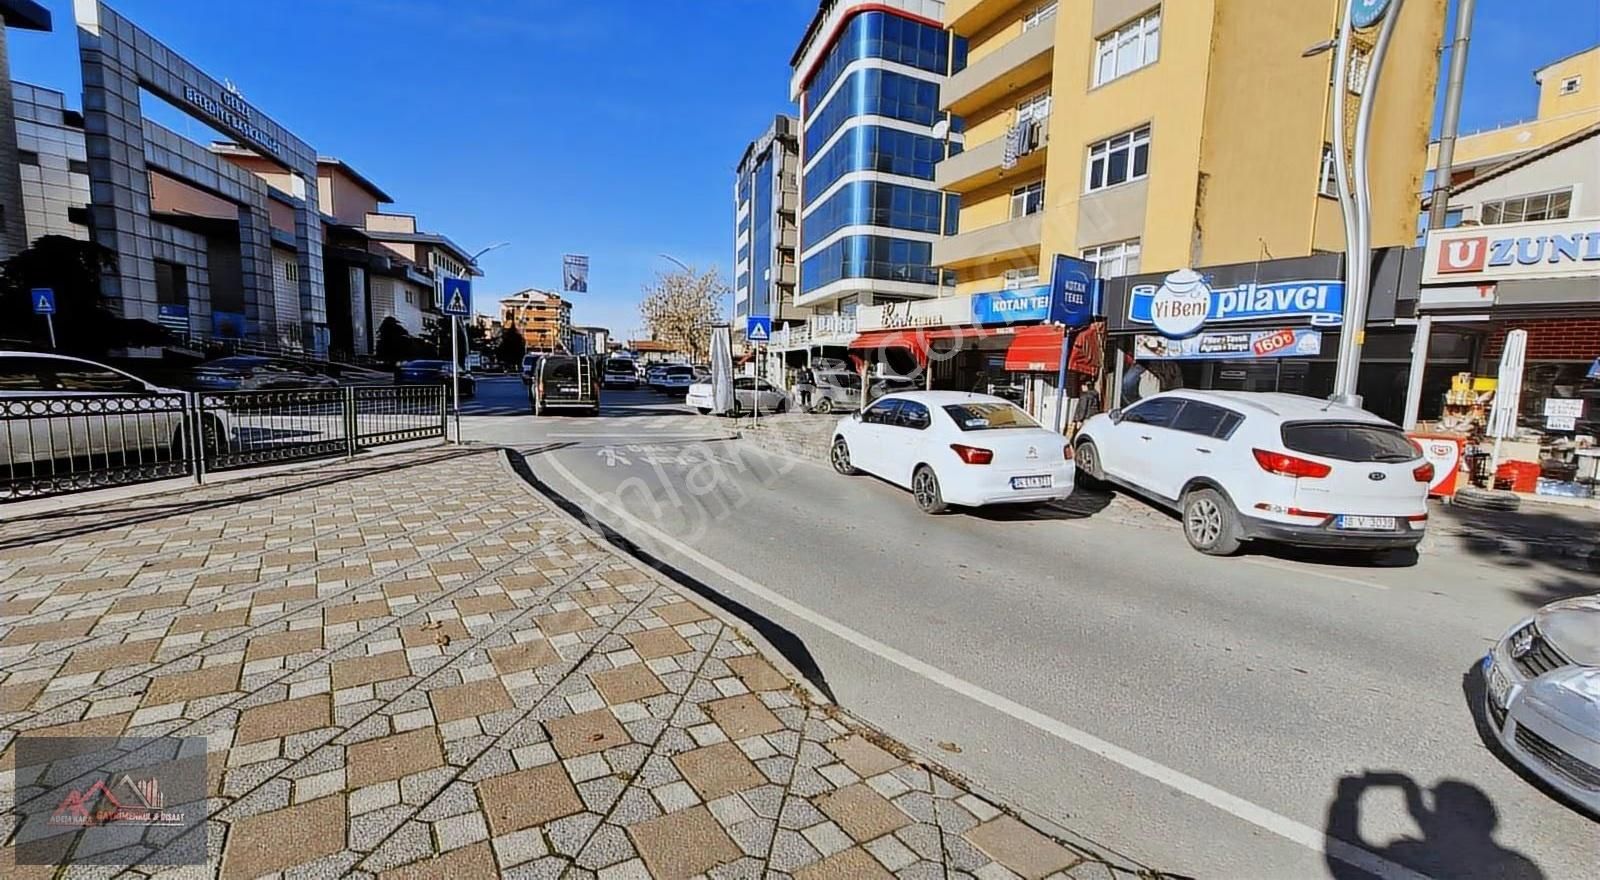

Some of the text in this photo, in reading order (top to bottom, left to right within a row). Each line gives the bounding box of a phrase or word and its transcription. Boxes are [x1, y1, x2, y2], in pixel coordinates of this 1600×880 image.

[1065, 280, 1086, 293] KOTAN
[992, 297, 1029, 312] KOTAN
[1065, 292, 1084, 304] TEKEL
[1155, 297, 1207, 318] Yi Beni
